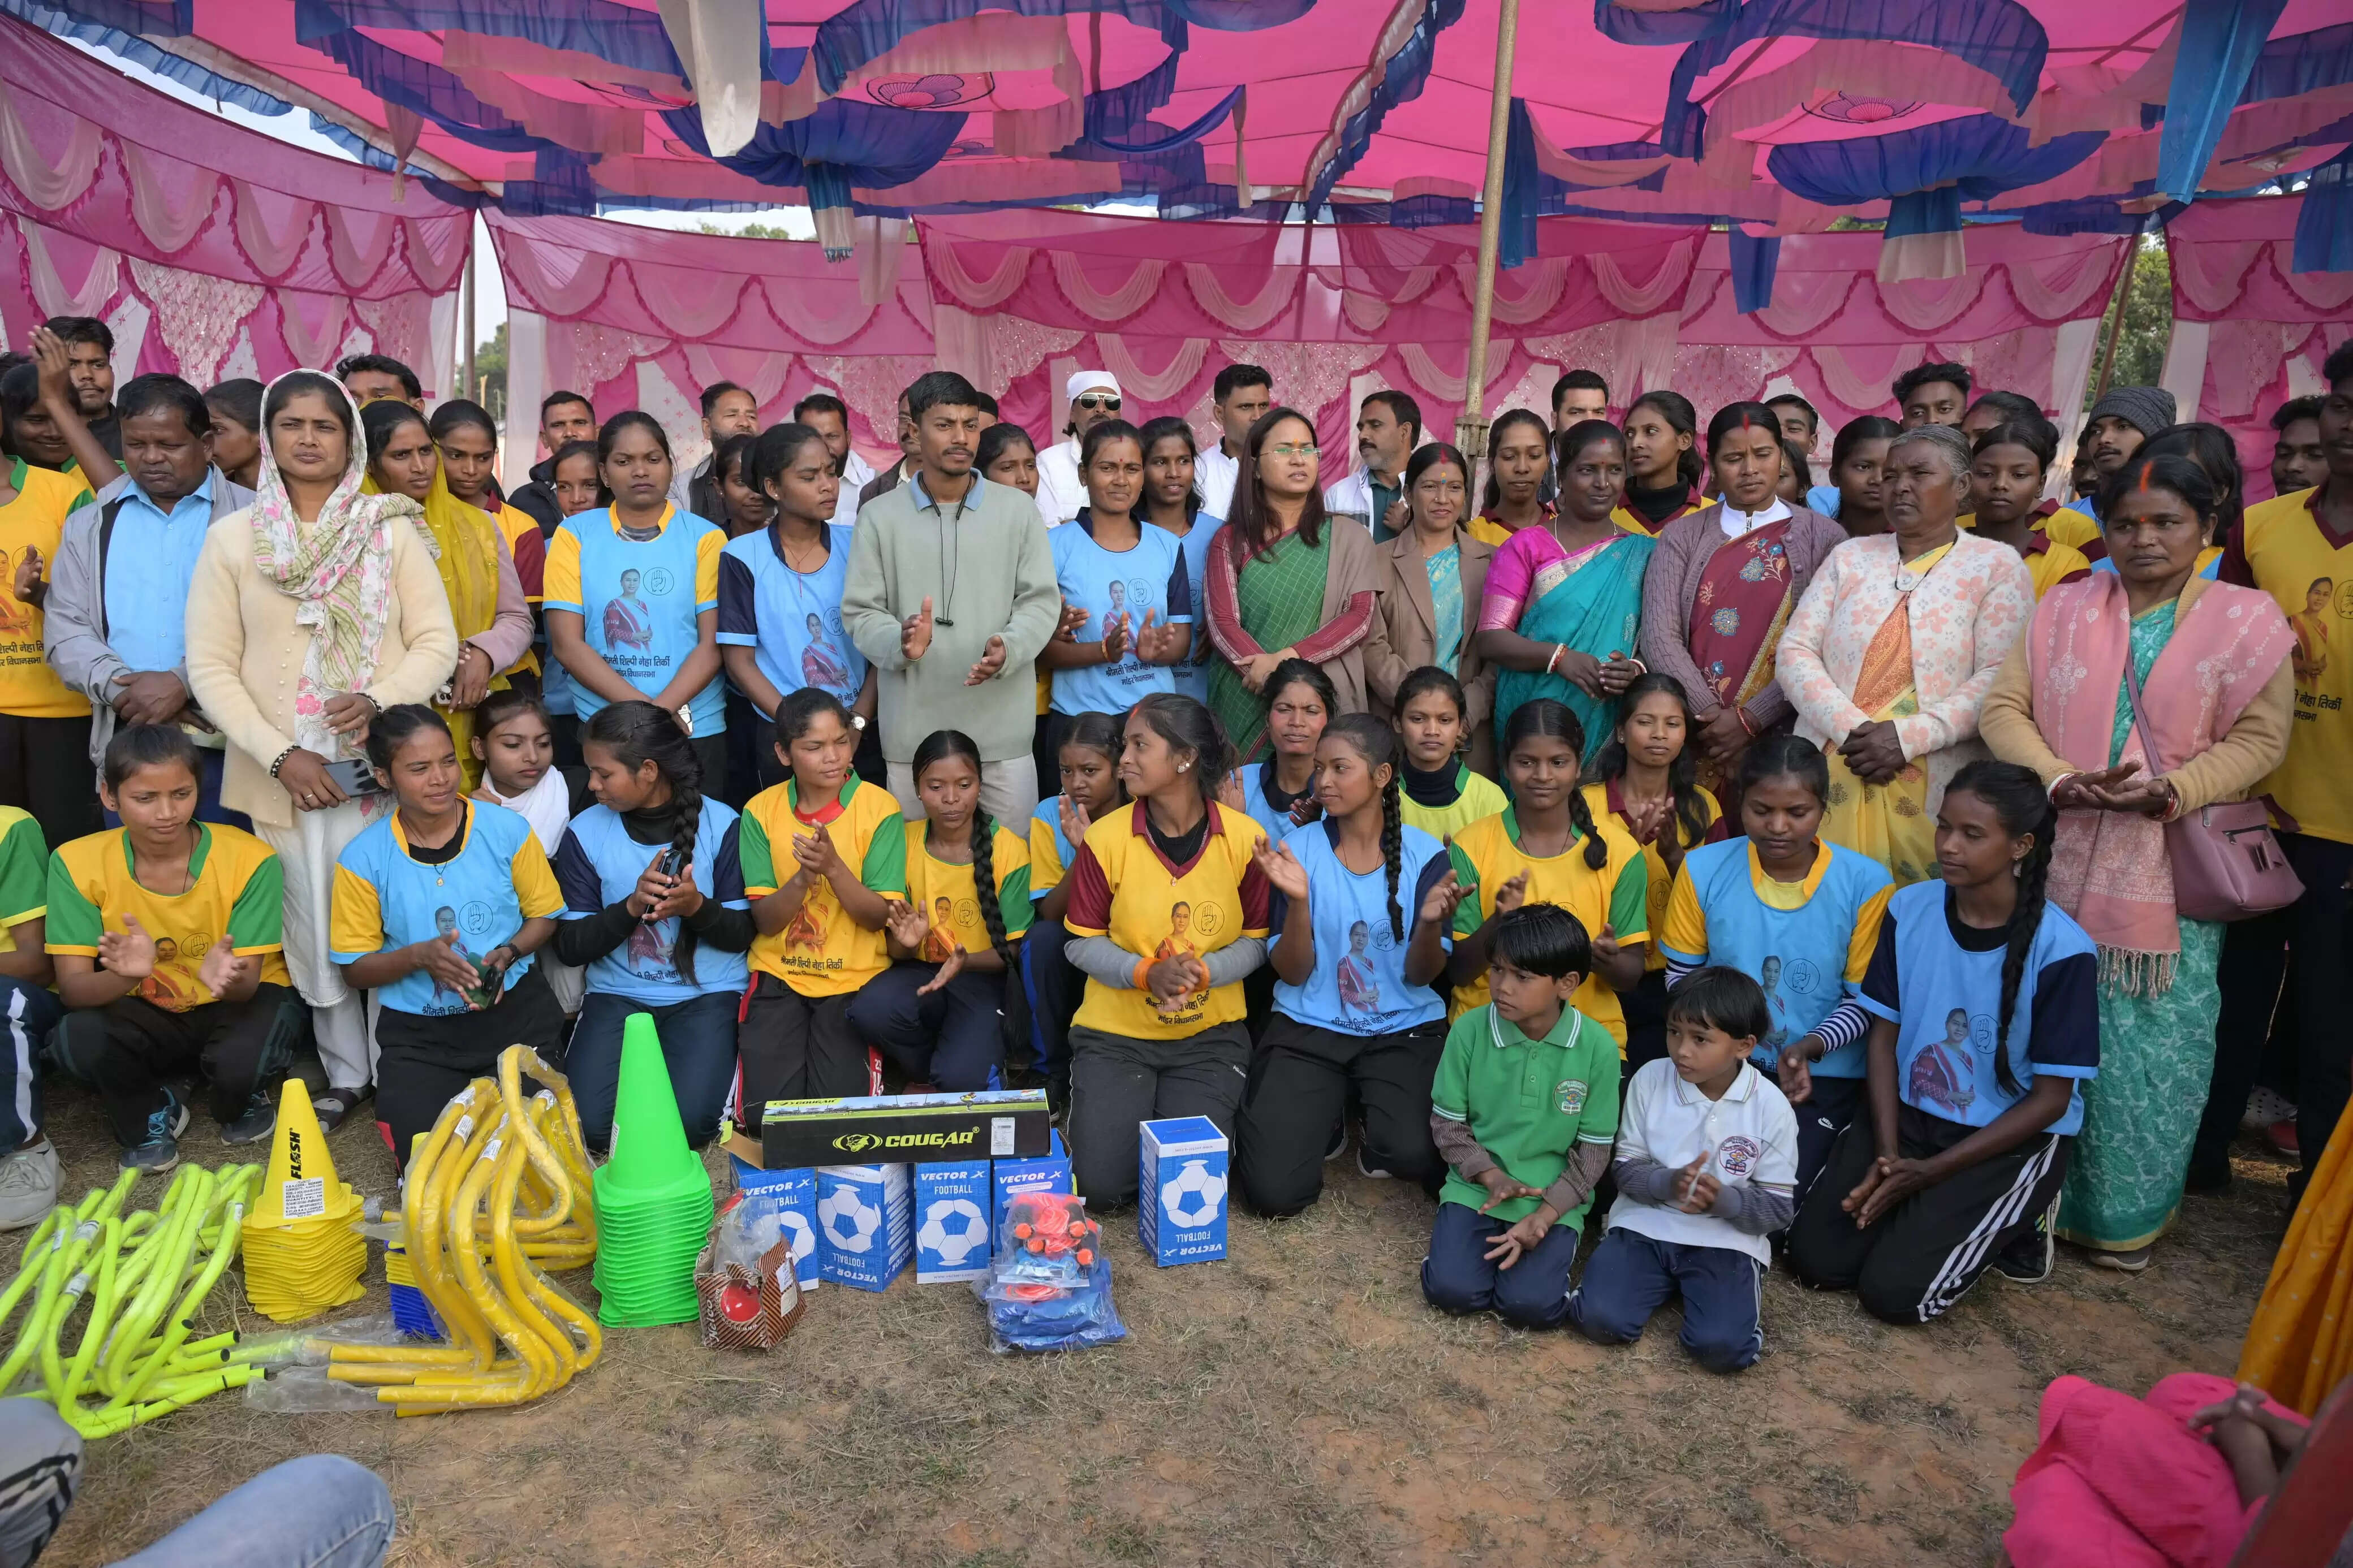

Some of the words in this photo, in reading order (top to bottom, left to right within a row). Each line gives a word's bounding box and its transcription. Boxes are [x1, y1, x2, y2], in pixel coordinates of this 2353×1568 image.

[639, 655, 652, 667] नेहा
[654, 655, 670, 667] तिर्की
[1106, 666, 1124, 677] श्रीमती
[1174, 1012, 1204, 1025] विधानसभा
[920, 1172, 968, 1181] VECTOR
[999, 1172, 1046, 1184] VECTOR
[1048, 1170, 1062, 1179] X
[746, 1182, 793, 1196] VECTOR
[795, 1178, 810, 1188] X
[934, 1185, 973, 1195] FOOTBALL
[1176, 1230, 1211, 1243] FOOTBALL
[1163, 1249, 1178, 1257] X
[1180, 1243, 1222, 1255] VECTOR
[833, 1252, 865, 1268] FOOTBALL
[891, 1245, 912, 1272] VECTOR
[822, 1264, 835, 1272] X
[837, 1268, 878, 1283] VECTOR
